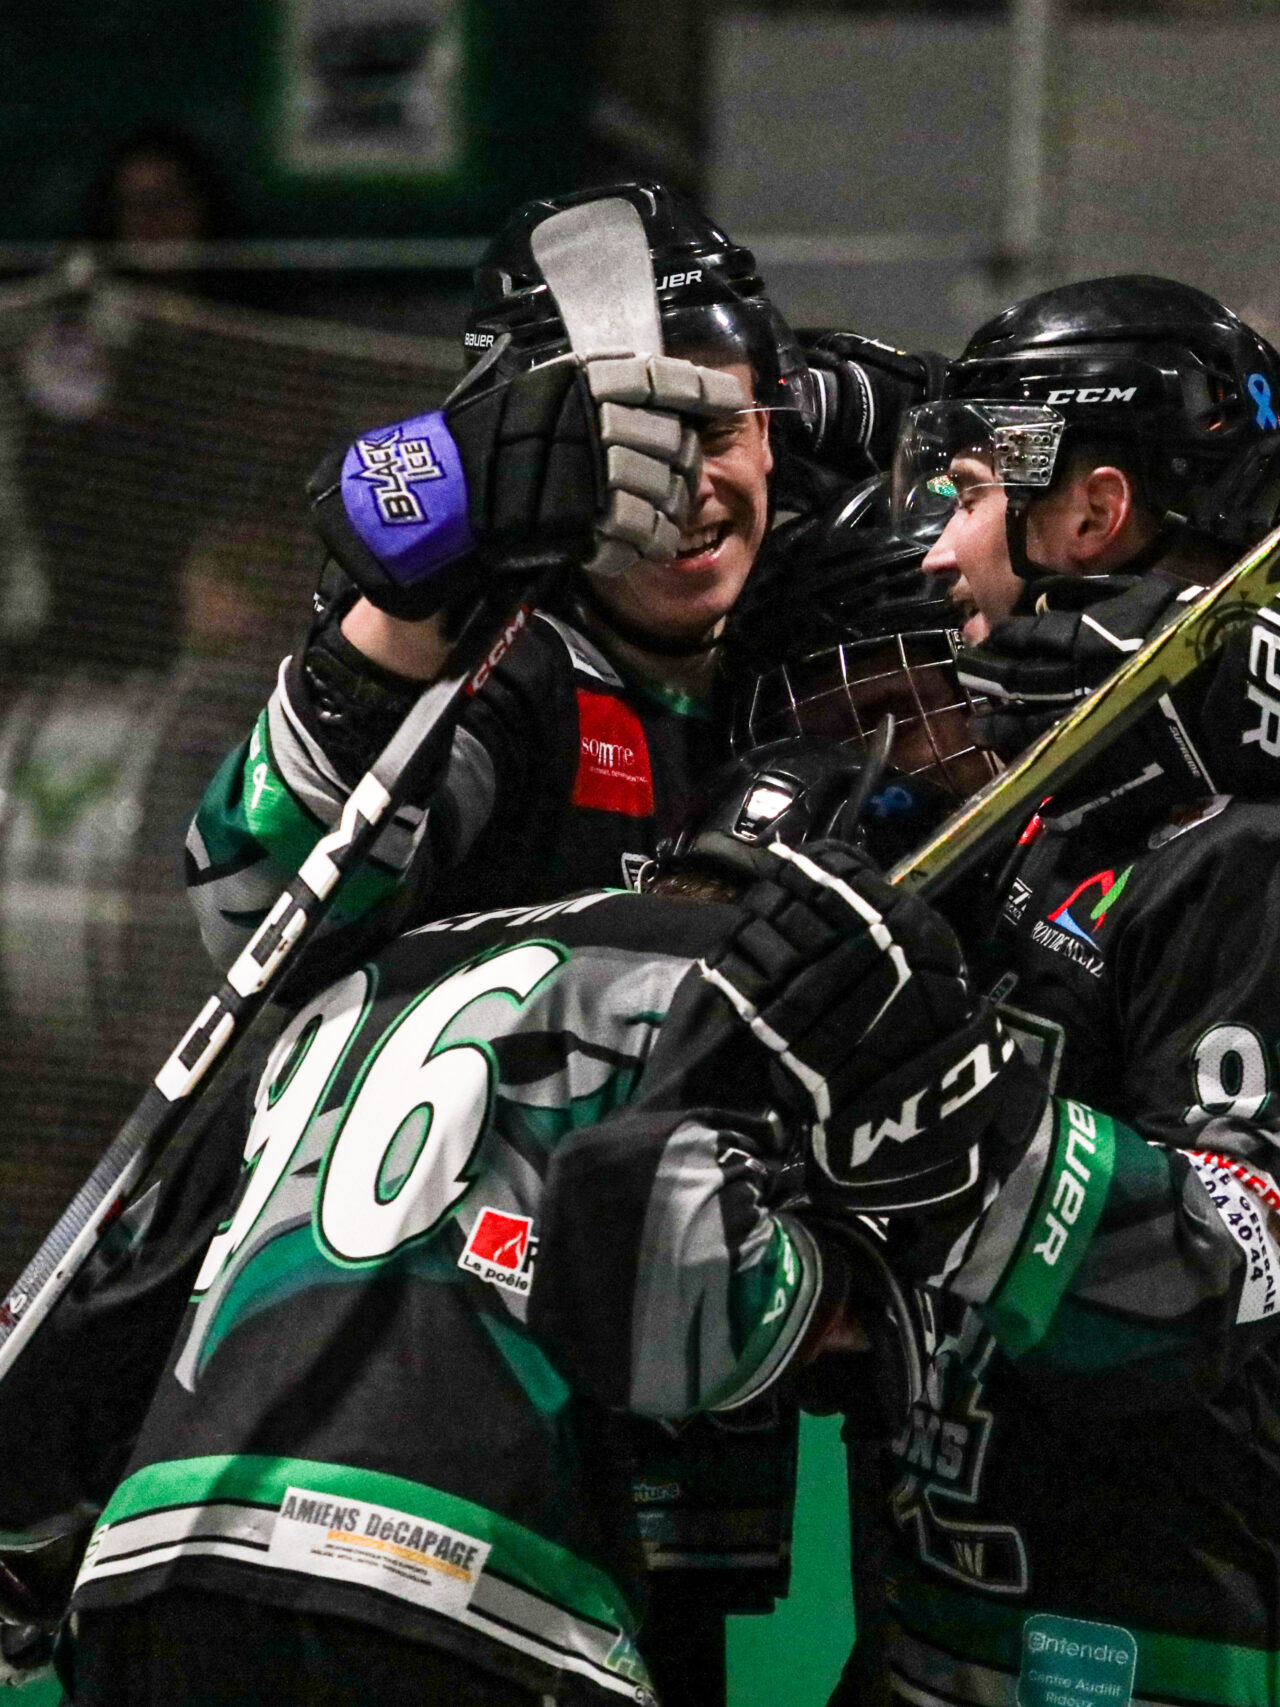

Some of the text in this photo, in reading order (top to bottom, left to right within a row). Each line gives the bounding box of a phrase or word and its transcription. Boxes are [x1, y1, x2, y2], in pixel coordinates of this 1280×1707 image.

[655, 269, 703, 291] UER
[1046, 387, 1137, 405] CCM
[357, 429, 425, 522] BLACK
[403, 439, 441, 481] ICE
[472, 609, 526, 692] CCM
[154, 772, 391, 1102] CCM
[190, 941, 569, 1296] 96
[850, 1018, 1015, 1168] CM
[1033, 1103, 1096, 1266] AUER
[463, 1255, 482, 1271] Le
[281, 1495, 360, 1532] AMIENS
